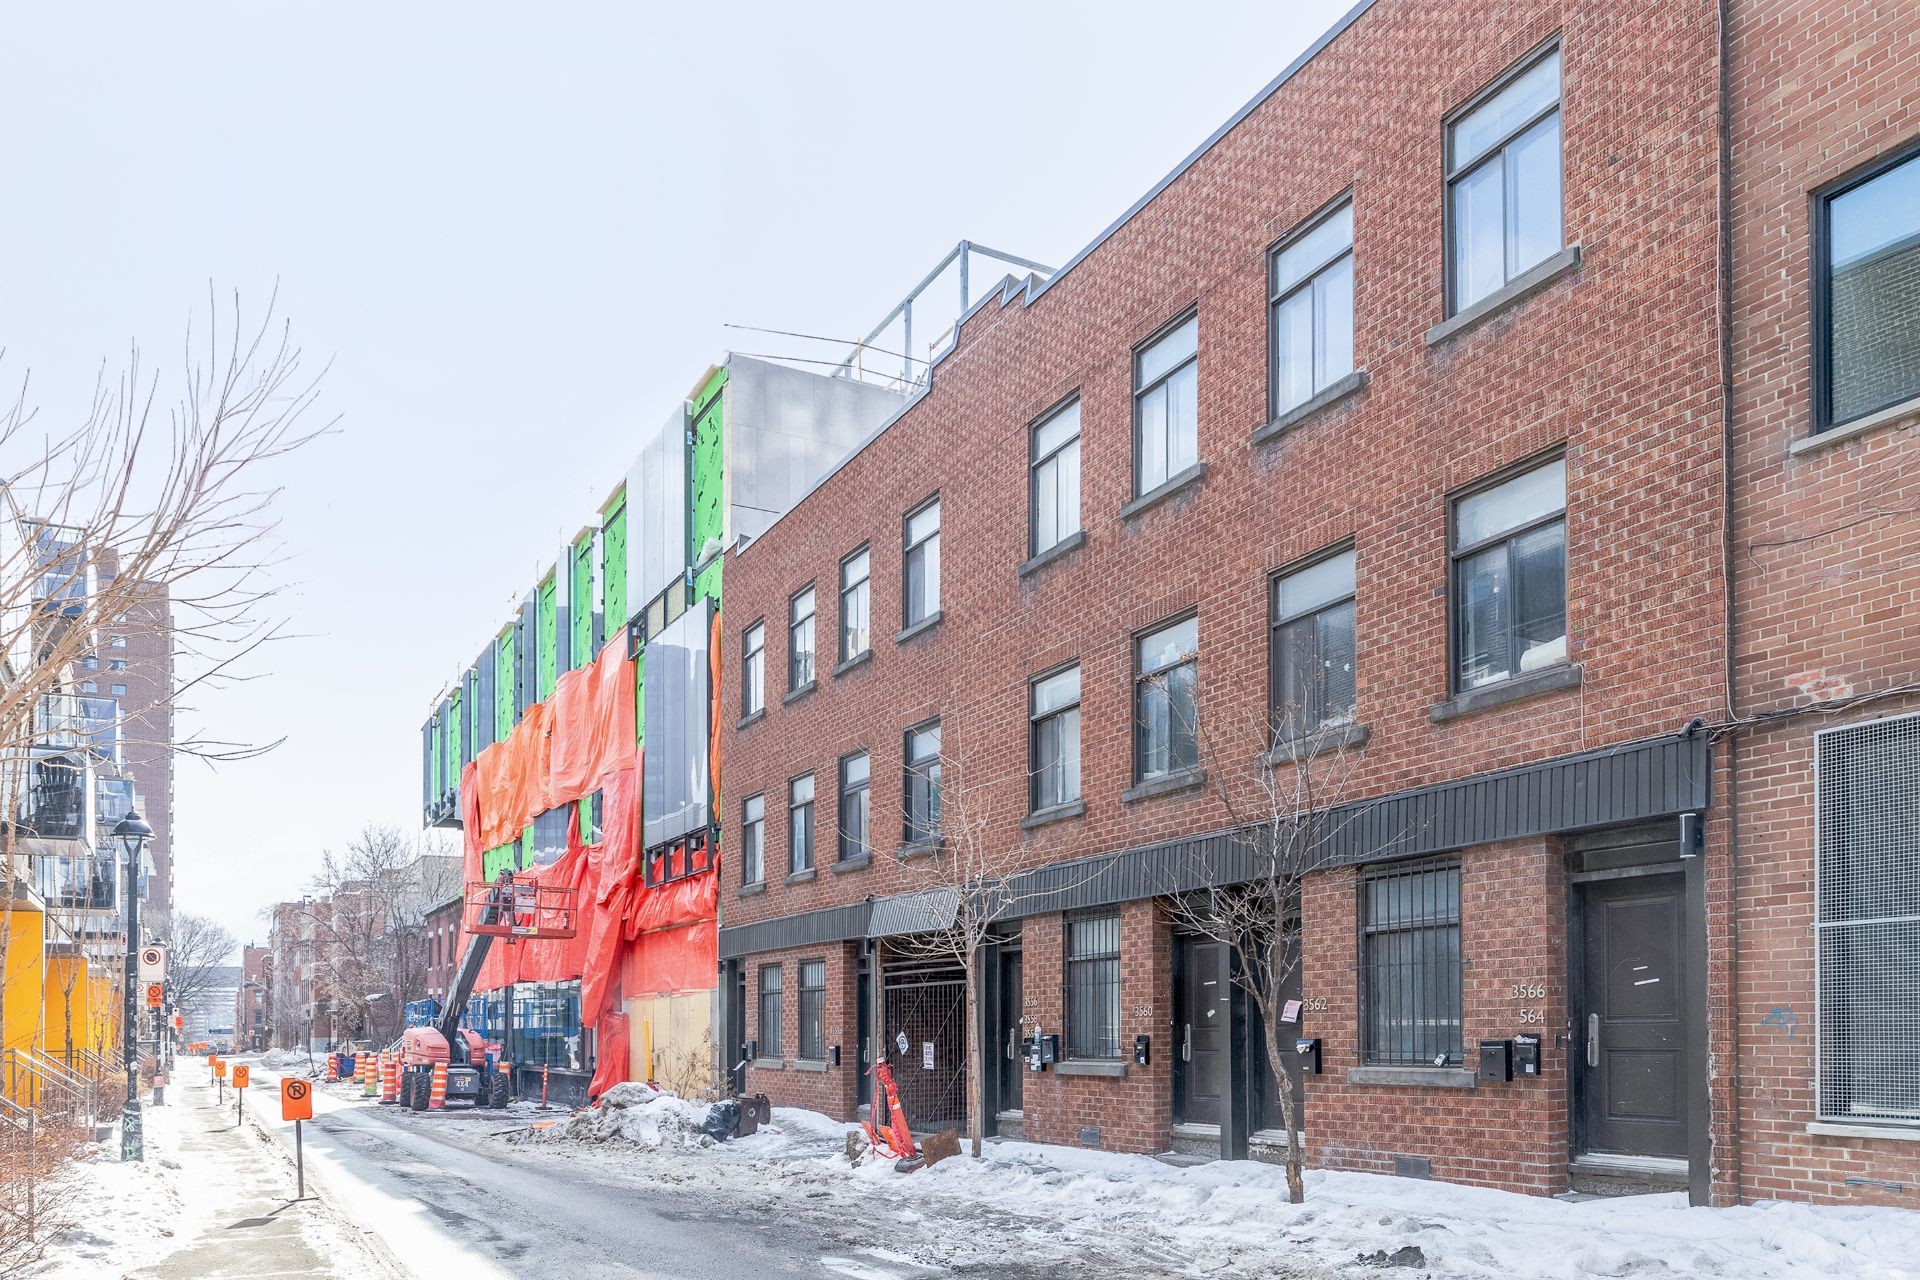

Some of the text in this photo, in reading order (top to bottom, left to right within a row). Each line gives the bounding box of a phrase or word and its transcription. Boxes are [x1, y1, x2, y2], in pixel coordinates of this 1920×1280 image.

[1511, 983, 1546, 999] 3566
[1135, 1005, 1153, 1017] 3560
[1303, 997, 1328, 1011] 3562
[1519, 1009, 1545, 1024] 564
[1024, 1029, 1035, 1038] 355
